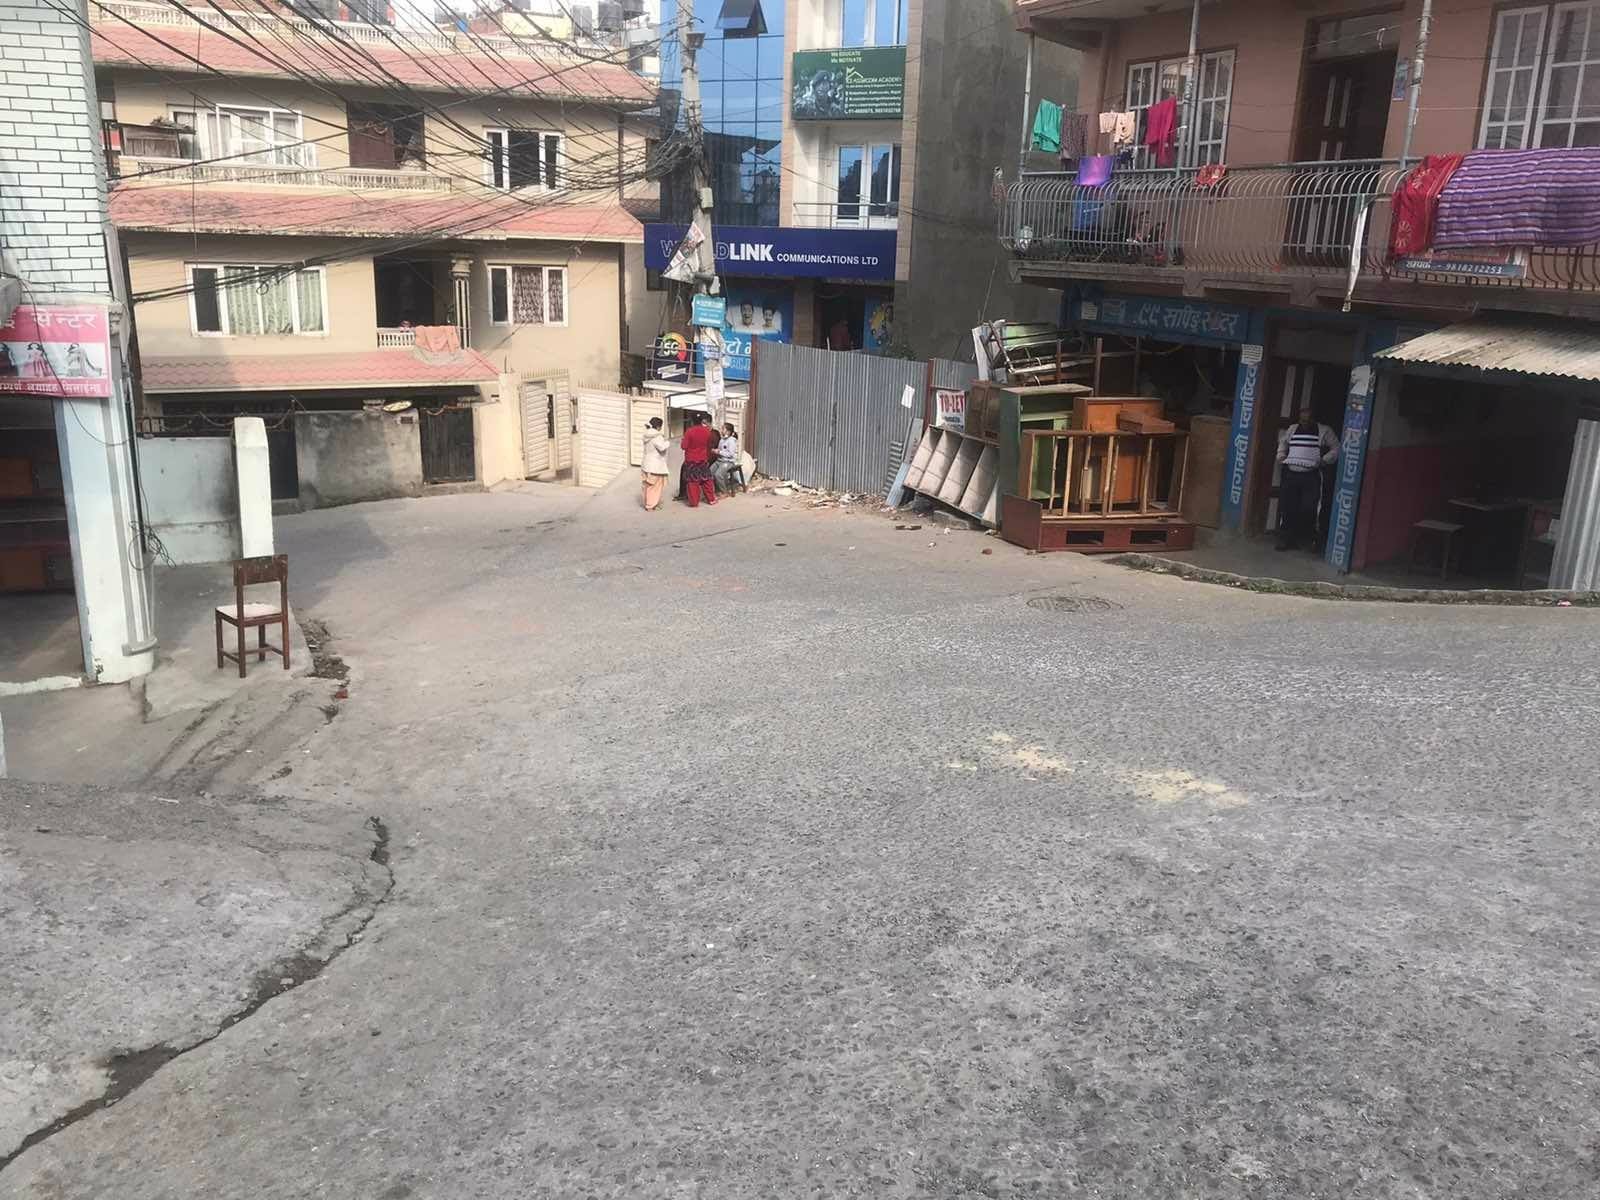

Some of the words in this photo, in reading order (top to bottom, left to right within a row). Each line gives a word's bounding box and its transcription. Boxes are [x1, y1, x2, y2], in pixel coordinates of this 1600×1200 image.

[660, 239, 774, 262] WDLINK
[777, 253, 860, 265] COMMUNICATIONS
[861, 256, 878, 265] LTD
[1446, 263, 1503, 274] 9818212253
[940, 394, 964, 413] TO-LET
